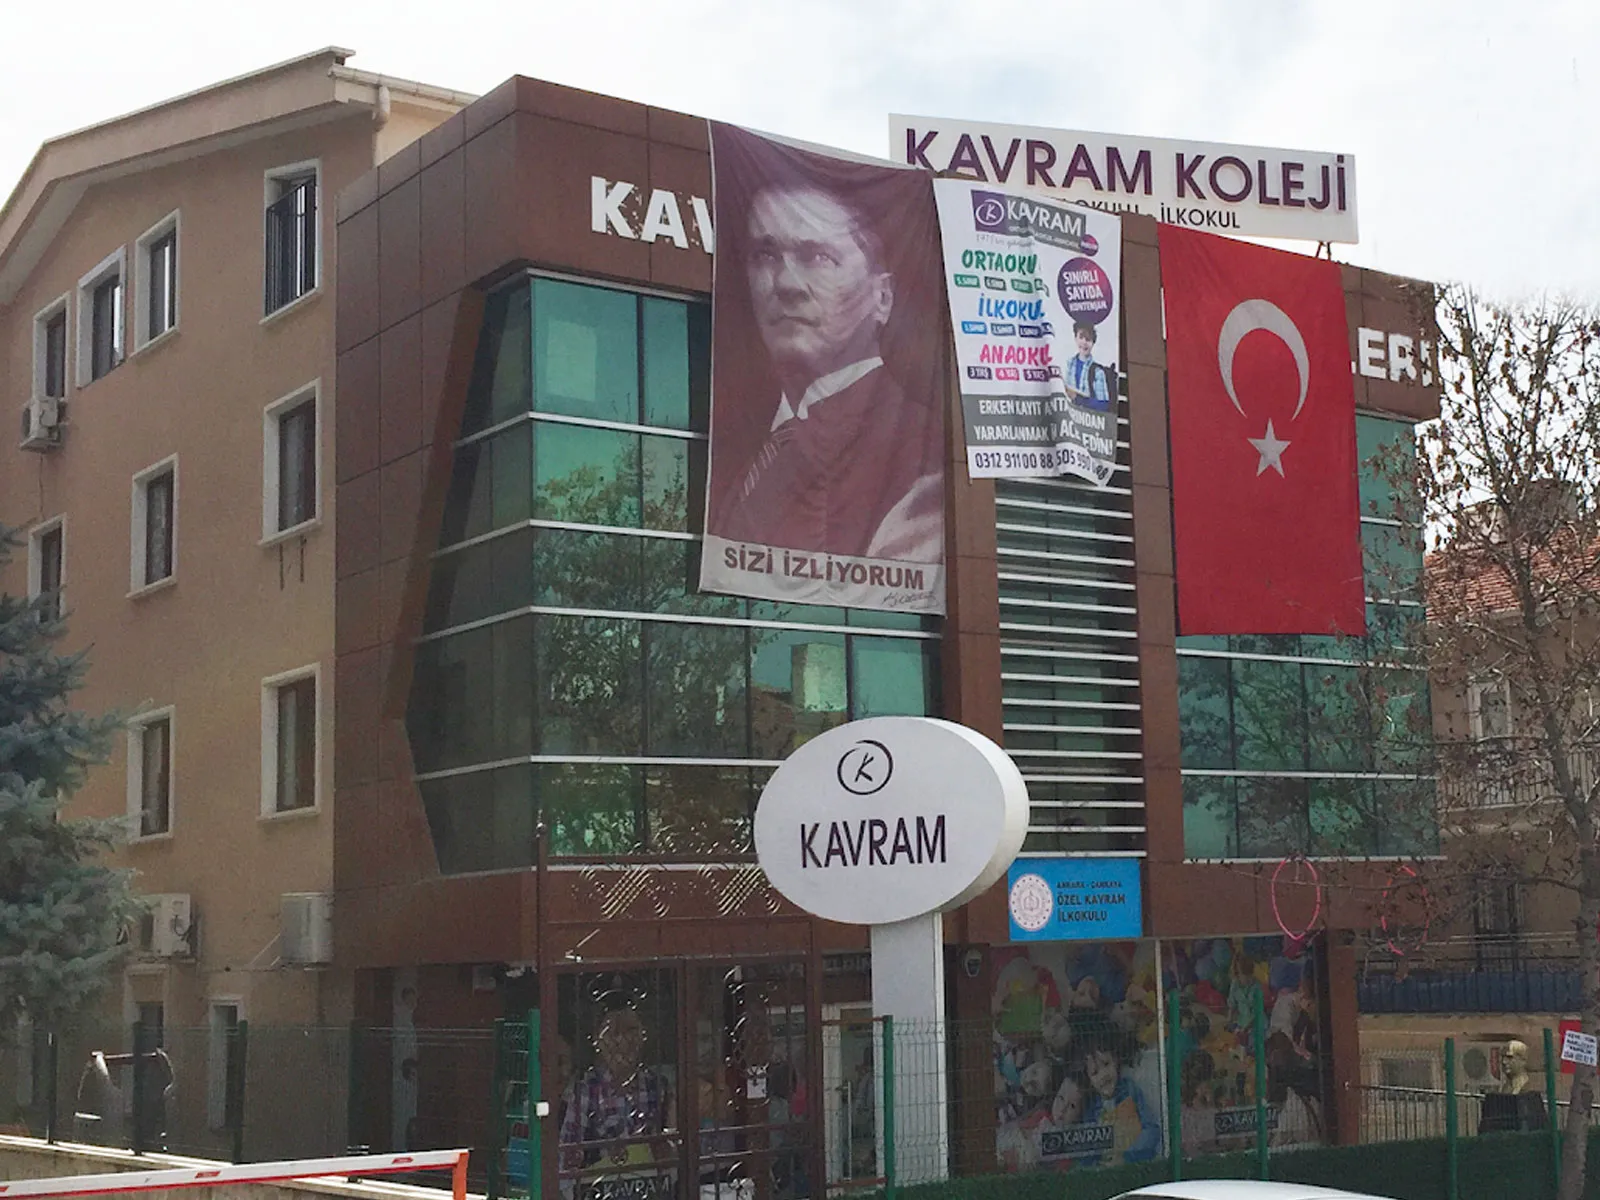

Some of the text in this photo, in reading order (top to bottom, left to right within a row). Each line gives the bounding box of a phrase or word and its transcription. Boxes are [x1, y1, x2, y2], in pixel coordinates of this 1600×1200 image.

[906, 128, 1346, 213] KAVRAM KOLEJİ
[1006, 200, 1082, 237] KAVRAM
[1160, 202, 1241, 229] İLKOKUL
[961, 249, 1041, 276] ORTAOKU
[1062, 269, 1100, 286] SINIRLI
[1066, 284, 1105, 301] SAYIDA
[978, 292, 1046, 322] İLKOKU
[979, 343, 1053, 367] ANAOKU
[978, 399, 1015, 415] ERKEN
[1015, 401, 1041, 416] KAYIT
[1081, 432, 1114, 456] EDİN!
[974, 452, 1002, 469] 0312
[723, 544, 925, 591] SİZİ İZLİYORUM
[800, 814, 947, 869] KAVRAM
[1057, 892, 1126, 906] ÖZEL KAVRAM
[1057, 908, 1108, 923] İLKOKULU
[1063, 1126, 1112, 1146] KAVRAM
